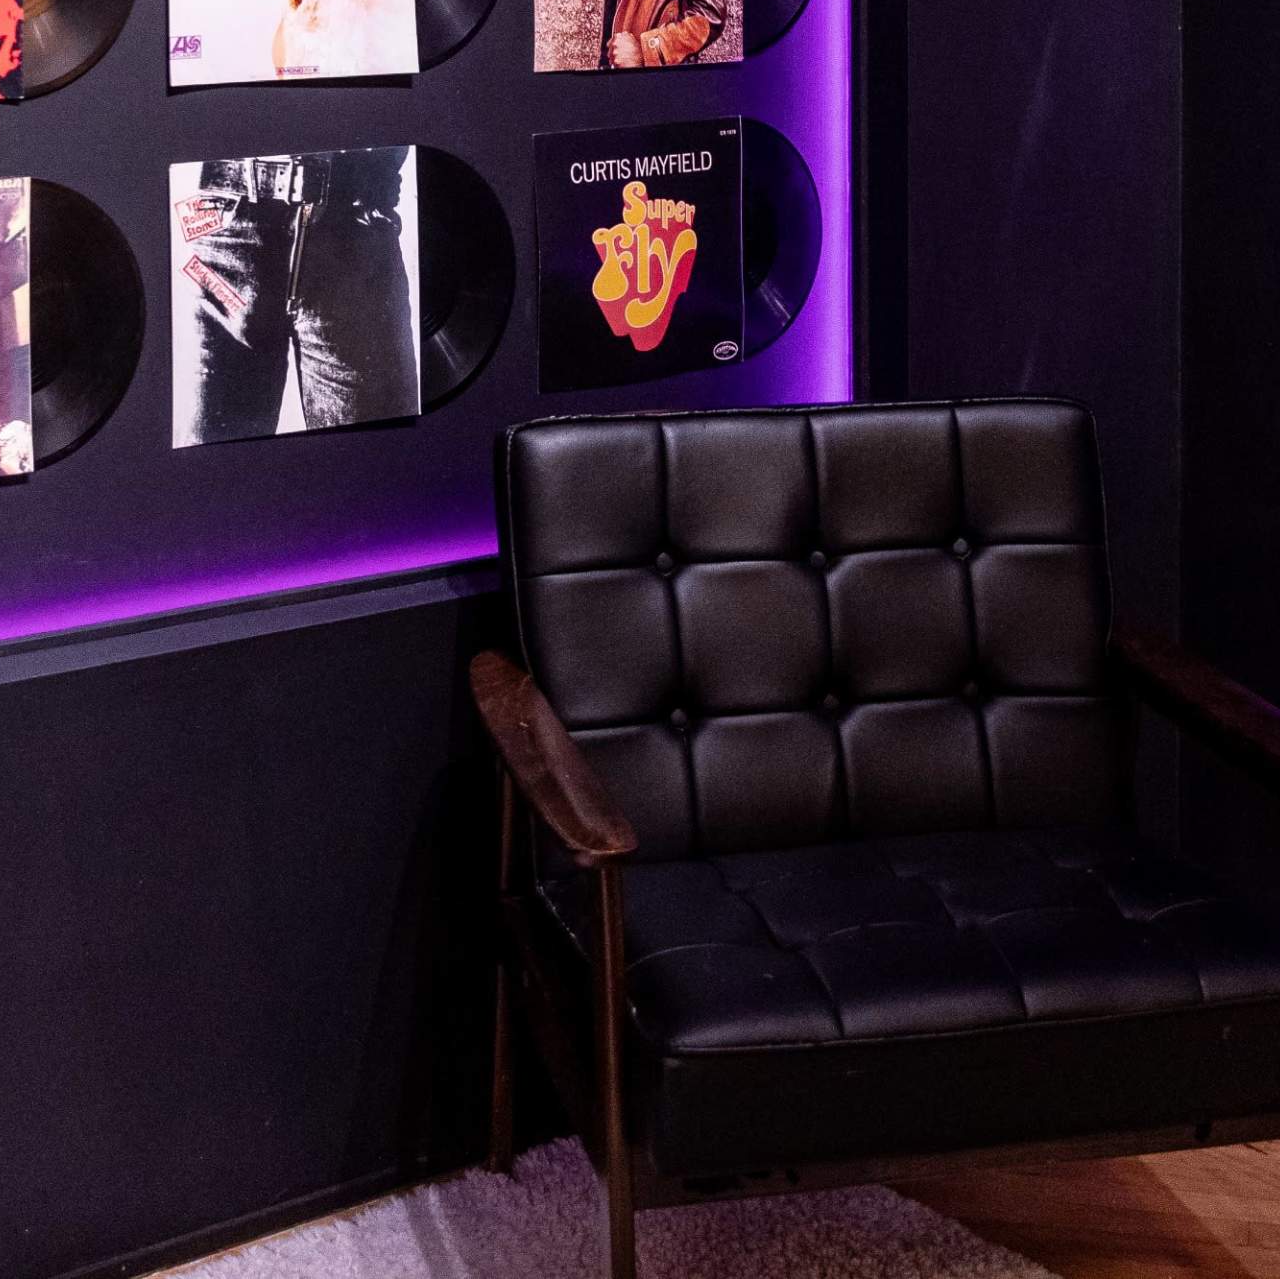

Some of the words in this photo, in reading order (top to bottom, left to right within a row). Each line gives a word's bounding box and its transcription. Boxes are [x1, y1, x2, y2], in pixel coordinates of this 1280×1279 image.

[570, 158, 631, 185] CURTIS
[634, 151, 713, 178] MAYFIELD
[622, 180, 696, 229] Super
[592, 223, 698, 328] Fly
